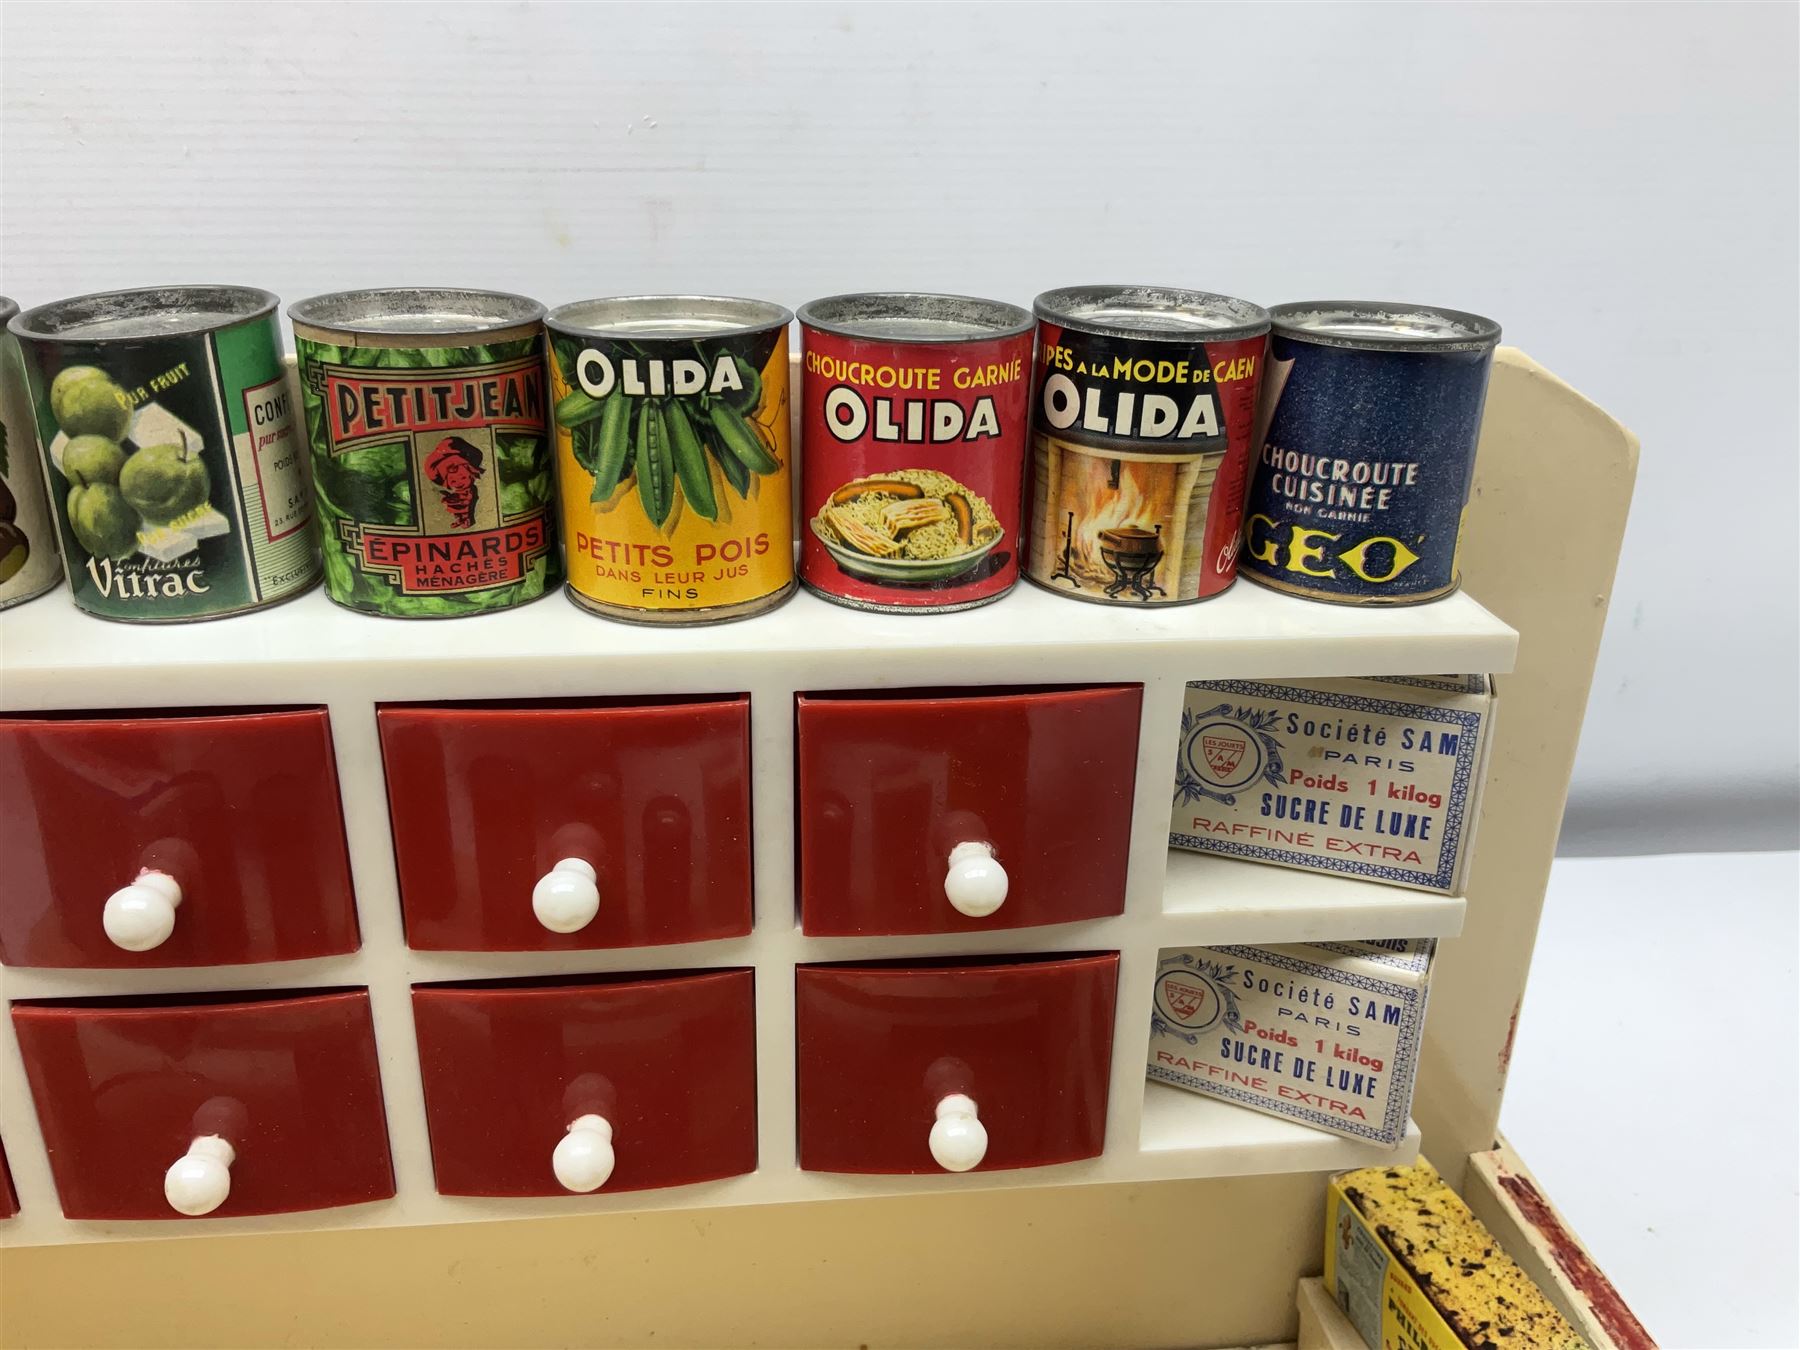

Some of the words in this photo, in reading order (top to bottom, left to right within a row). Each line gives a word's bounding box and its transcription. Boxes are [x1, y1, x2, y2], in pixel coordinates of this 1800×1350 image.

[150, 362, 190, 392] FRUIT
[576, 348, 744, 398] OLIDA
[806, 350, 940, 390] CHOUCROUTE
[953, 359, 1022, 389] GARNIE
[1041, 343, 1074, 371] IPES
[1076, 361, 1087, 375] A
[1091, 363, 1110, 378] LA
[1112, 356, 1189, 384] MODE
[1192, 371, 1210, 383] DE
[1213, 355, 1255, 384] CAEN
[336, 371, 542, 436] PETITJEAN
[824, 384, 1002, 444] OLIDA
[1043, 373, 1220, 439] OLIDA
[1262, 443, 1419, 486] CHOUCROUTE
[1272, 473, 1393, 510] CUISINÉE
[369, 527, 539, 562] ÉPINARDS
[576, 532, 673, 568] PETITS
[696, 533, 770, 566] POIS
[86, 556, 210, 598] Vitrac
[416, 557, 508, 575] HACHÉS
[596, 565, 641, 583] DANS
[655, 571, 705, 584] LEUR
[713, 564, 749, 581] JUS
[642, 588, 698, 599] FINS
[1286, 713, 1387, 747] Société
[1401, 728, 1458, 757] SAM
[1324, 751, 1415, 772] PARIS
[1289, 769, 1349, 793] Poids
[1367, 780, 1376, 796] 1
[1387, 782, 1442, 809] kilog
[1260, 793, 1329, 826] SUCRE
[1340, 805, 1364, 830] DE
[1375, 810, 1432, 841] LUXE
[1192, 817, 1314, 847] RAFFINÉ
[1326, 838, 1422, 865] EXTRA
[1243, 970, 1335, 1010] Société
[1348, 997, 1402, 1026] SAM
[1278, 1007, 1361, 1036] PARIS
[1244, 1020, 1298, 1047] Poids
[1315, 1039, 1324, 1054] 1
[1333, 1043, 1384, 1072] kilog
[1156, 1051, 1268, 1092] RAFFINÉ
[1277, 1086, 1367, 1120] EXTRA
[1220, 1037, 1282, 1073] SUCRE
[1293, 1057, 1316, 1083] DE
[1326, 1066, 1377, 1099] LUXE
